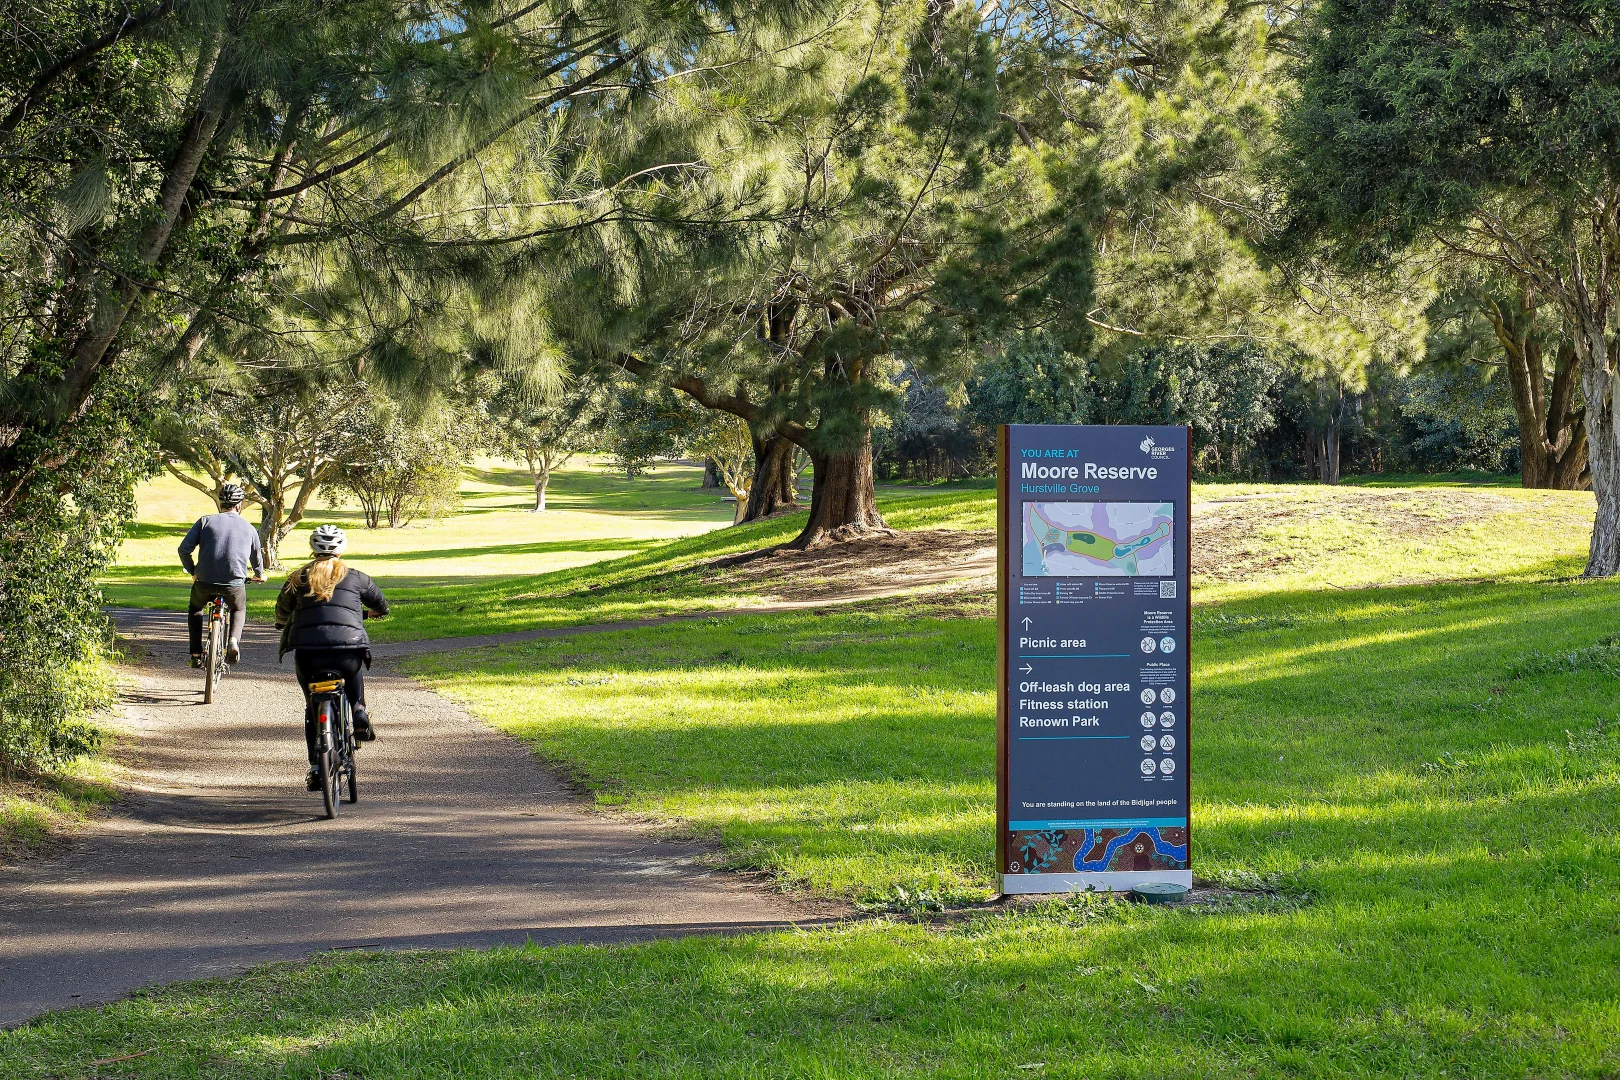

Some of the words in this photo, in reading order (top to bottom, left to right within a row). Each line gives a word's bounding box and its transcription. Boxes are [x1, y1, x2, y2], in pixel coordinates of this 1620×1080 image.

[1021, 449, 1042, 458] YOU
[1044, 449, 1064, 458] ARE
[1066, 449, 1079, 458] AT
[1022, 462, 1079, 479] Moore
[1084, 462, 1158, 480] Reserve
[1021, 484, 1066, 493] Hurstville
[1070, 484, 1100, 493] Grove
[1019, 637, 1057, 648] Picnic
[1060, 639, 1086, 648] area
[1019, 681, 1074, 693] Off-leash
[1078, 681, 1101, 694] dog
[1104, 683, 1130, 692] area
[1019, 699, 1064, 710] Fitness
[1067, 699, 1109, 709] station
[1019, 716, 1069, 727] Renown
[1072, 716, 1100, 727] Park
